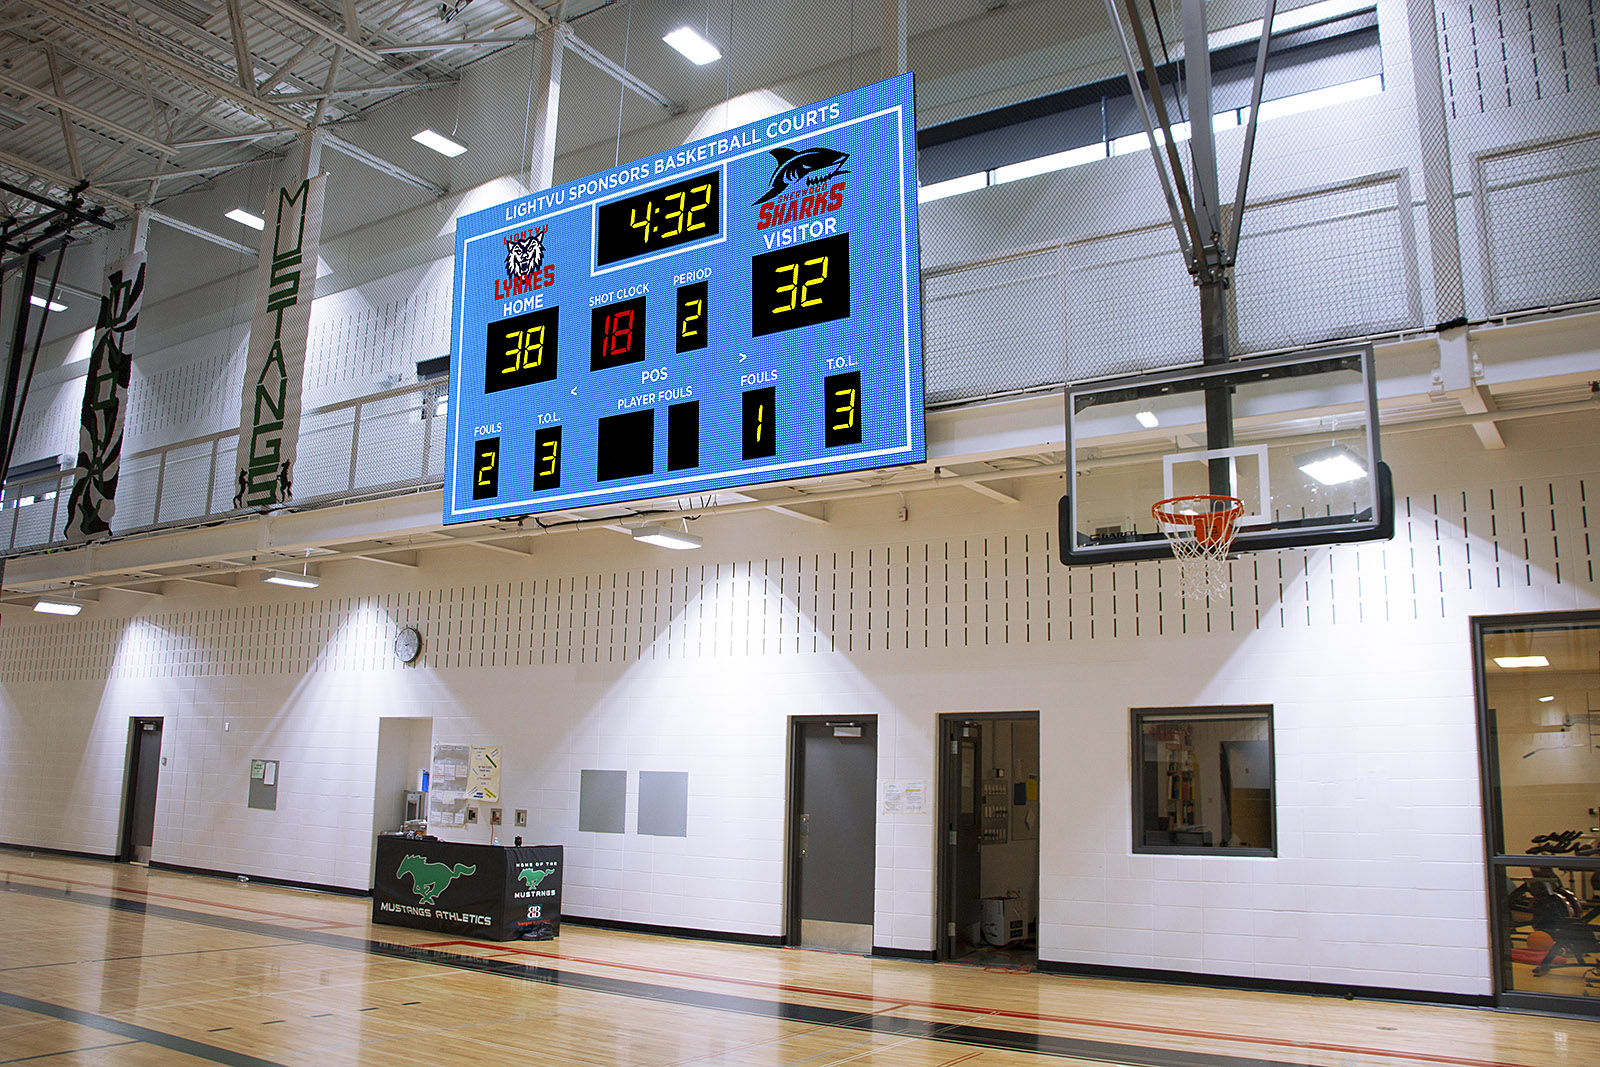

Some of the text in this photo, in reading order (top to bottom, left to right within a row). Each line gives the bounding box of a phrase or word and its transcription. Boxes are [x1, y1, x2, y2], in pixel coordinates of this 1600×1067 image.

[505, 103, 840, 221] LIGHTVU SPONSORS BASKETBALL COURTS
[756, 182, 846, 231] SHARKS
[777, 182, 828, 204] SHERWOOD
[630, 183, 712, 244] 4:32
[503, 224, 549, 245] LIGHTVU
[763, 217, 837, 250] VISITOR
[494, 264, 555, 301] LYNXES
[673, 267, 712, 286] PERIOD
[772, 256, 829, 314] 32
[503, 294, 544, 317] HOME
[589, 283, 650, 307] SHOT CLOCK
[602, 309, 634, 357] 18
[682, 299, 702, 338] 2
[248, 180, 309, 507] MUSTANGS
[501, 325, 546, 374] 38
[641, 367, 668, 384] POS
[740, 369, 778, 387] FOULS
[826, 355, 858, 370] T.O.L.
[617, 385, 693, 410] PLAYER FOULS
[832, 388, 856, 430] 3
[474, 422, 502, 437] FOULS
[537, 412, 561, 425] T.O.L.
[756, 404, 763, 442] 1
[478, 451, 496, 486] 2
[539, 440, 558, 476] 3
[514, 889, 557, 899] MUSTANGS
[380, 902, 492, 926] MUSTANGS ATHLETICS
